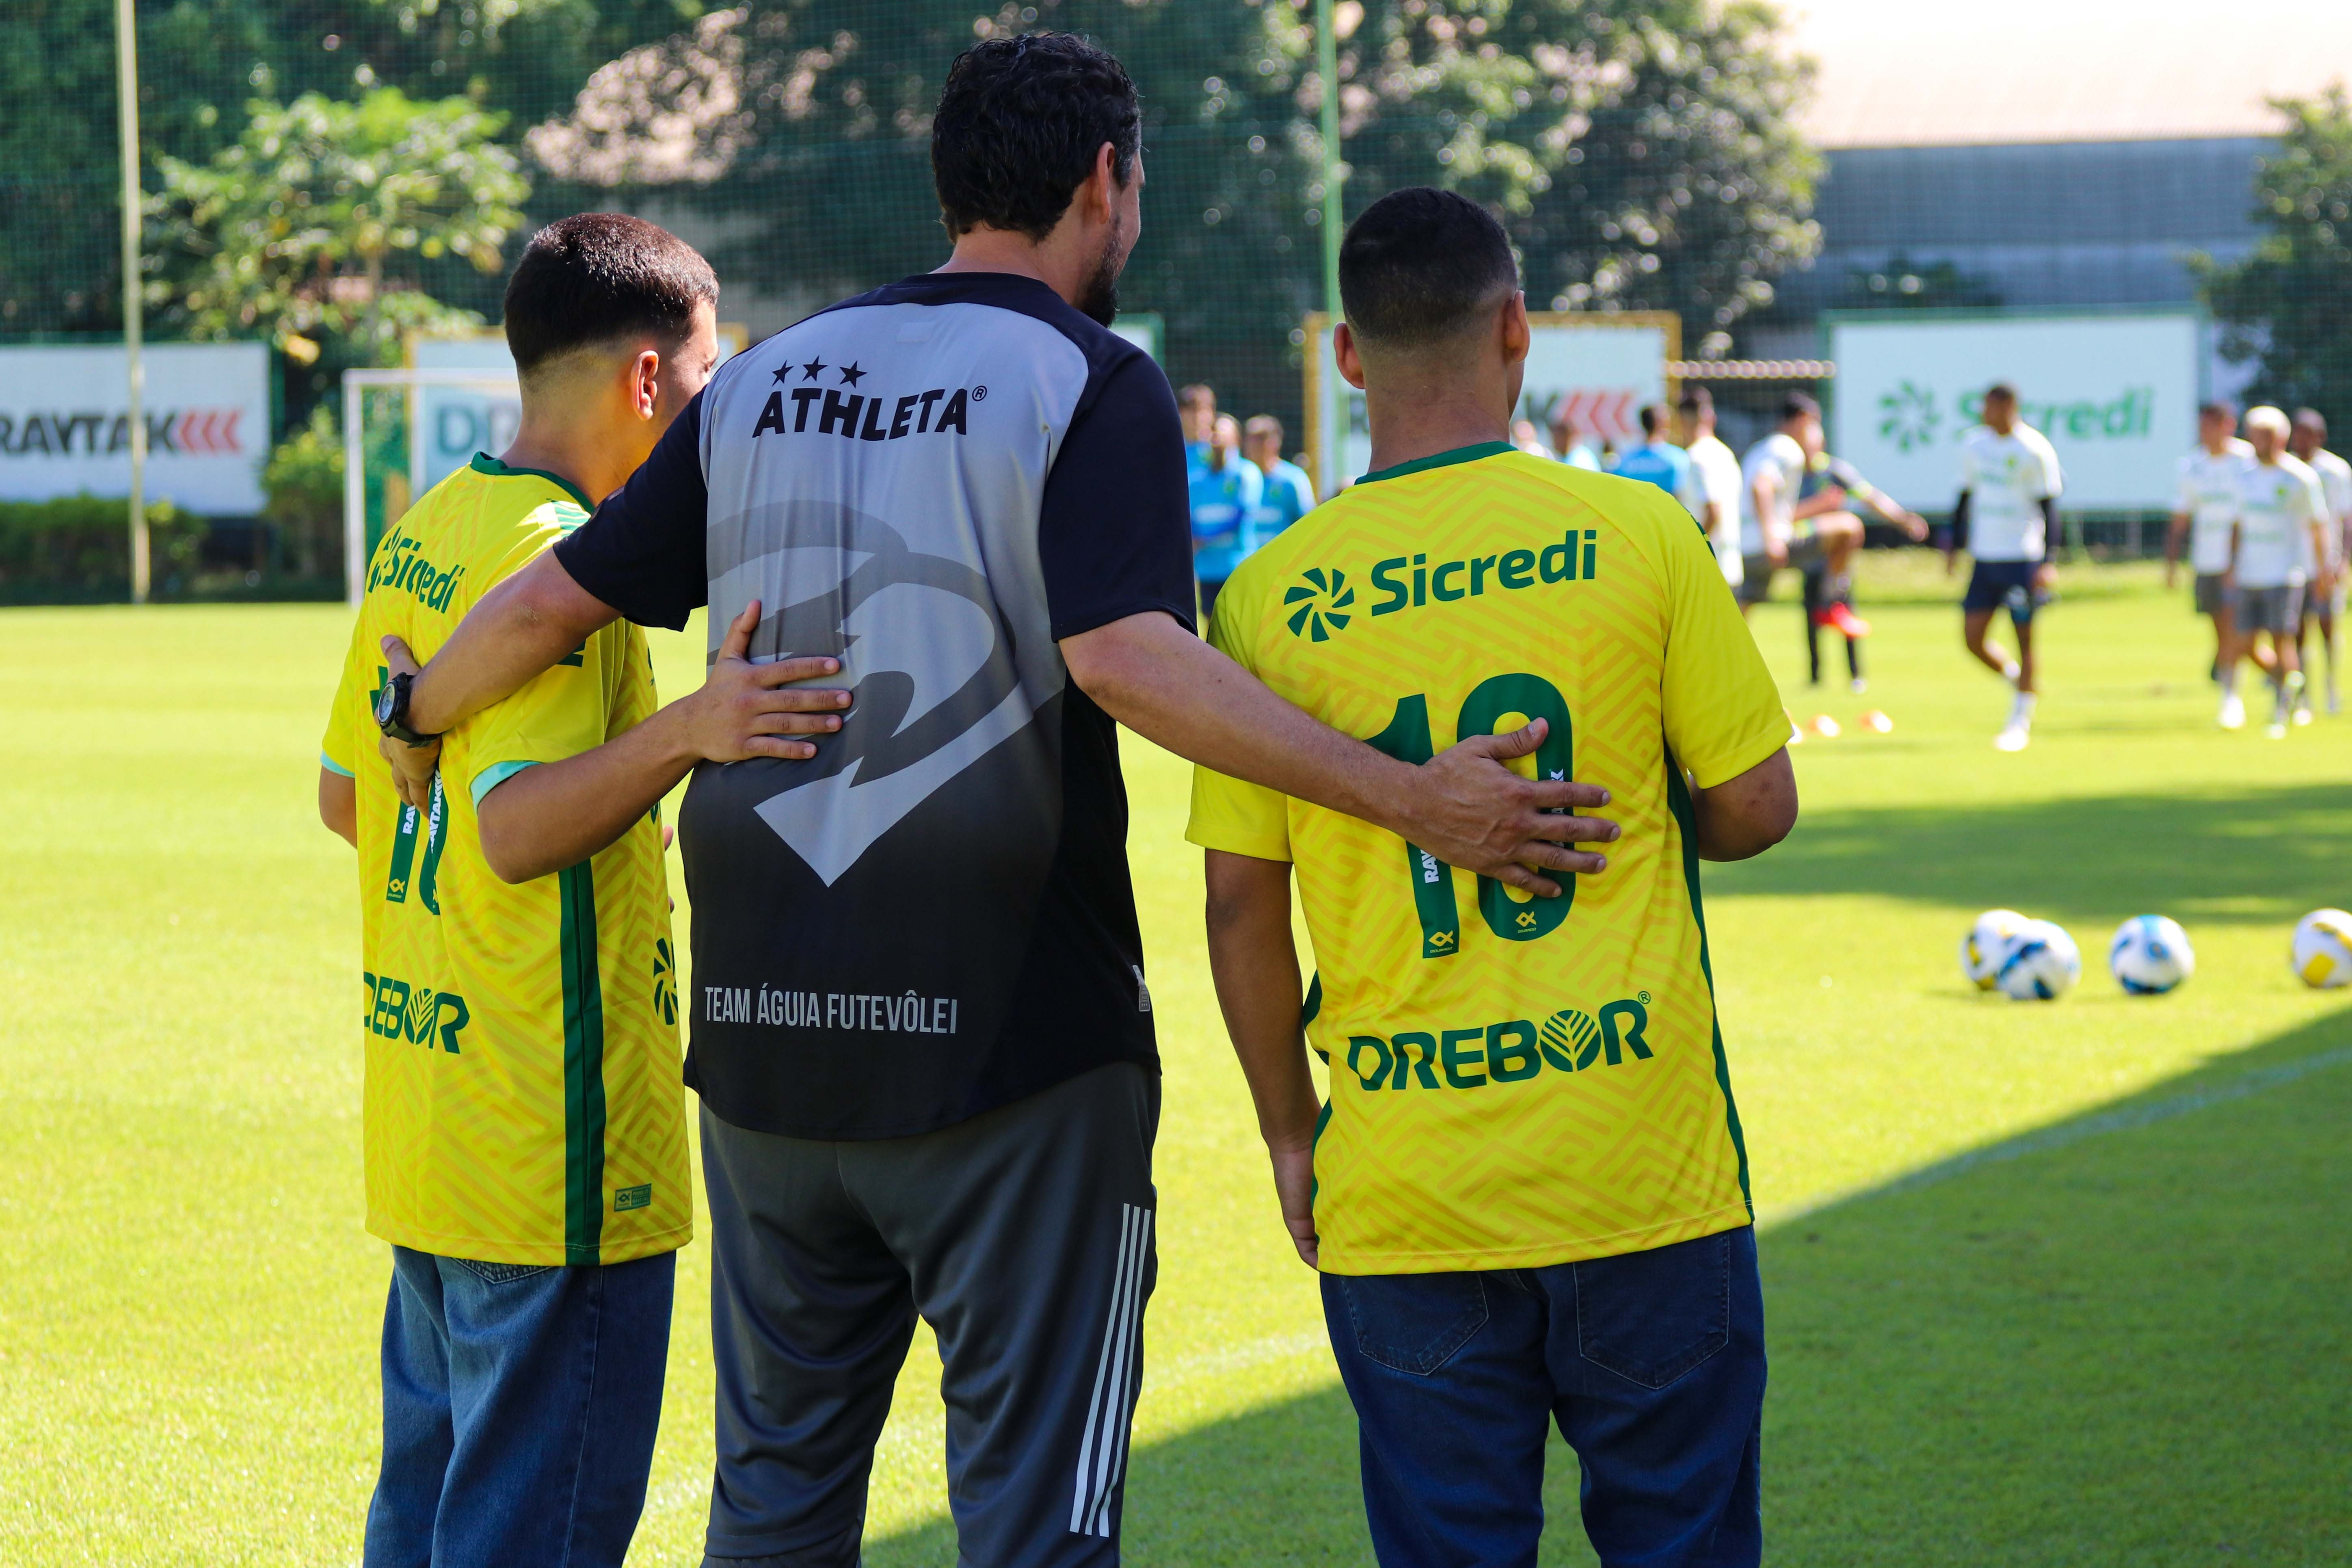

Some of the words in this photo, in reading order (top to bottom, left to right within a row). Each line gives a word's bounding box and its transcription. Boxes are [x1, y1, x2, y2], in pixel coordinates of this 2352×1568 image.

[1371, 530, 1597, 617] Sicredi
[705, 987, 750, 1023] TEAM
[757, 982, 820, 1027] ÁGUIA
[827, 990, 957, 1034] FUTEVÔLEI
